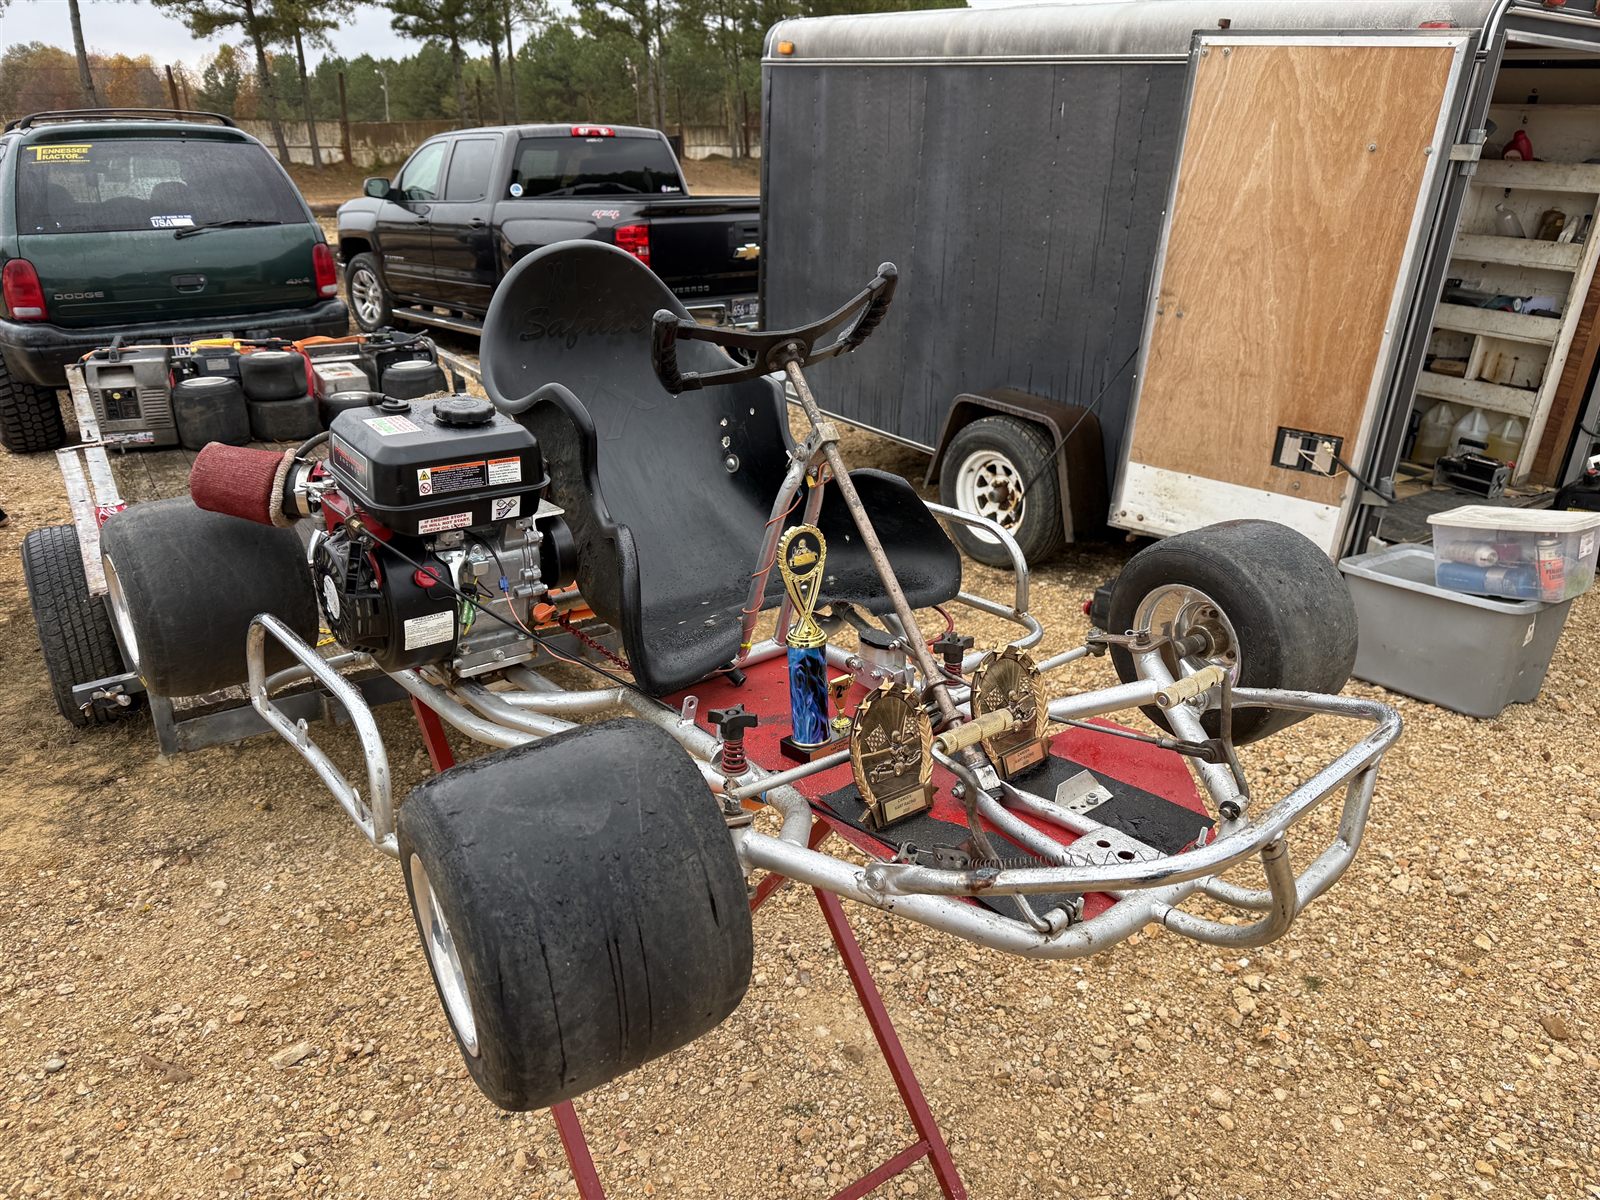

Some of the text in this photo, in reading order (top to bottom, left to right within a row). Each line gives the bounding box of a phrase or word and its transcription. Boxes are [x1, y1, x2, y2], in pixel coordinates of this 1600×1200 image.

[28, 144, 91, 160] TENNESSEE
[151, 219, 174, 227] USA
[673, 285, 710, 293] VERADO
[54, 291, 104, 300] DODGE
